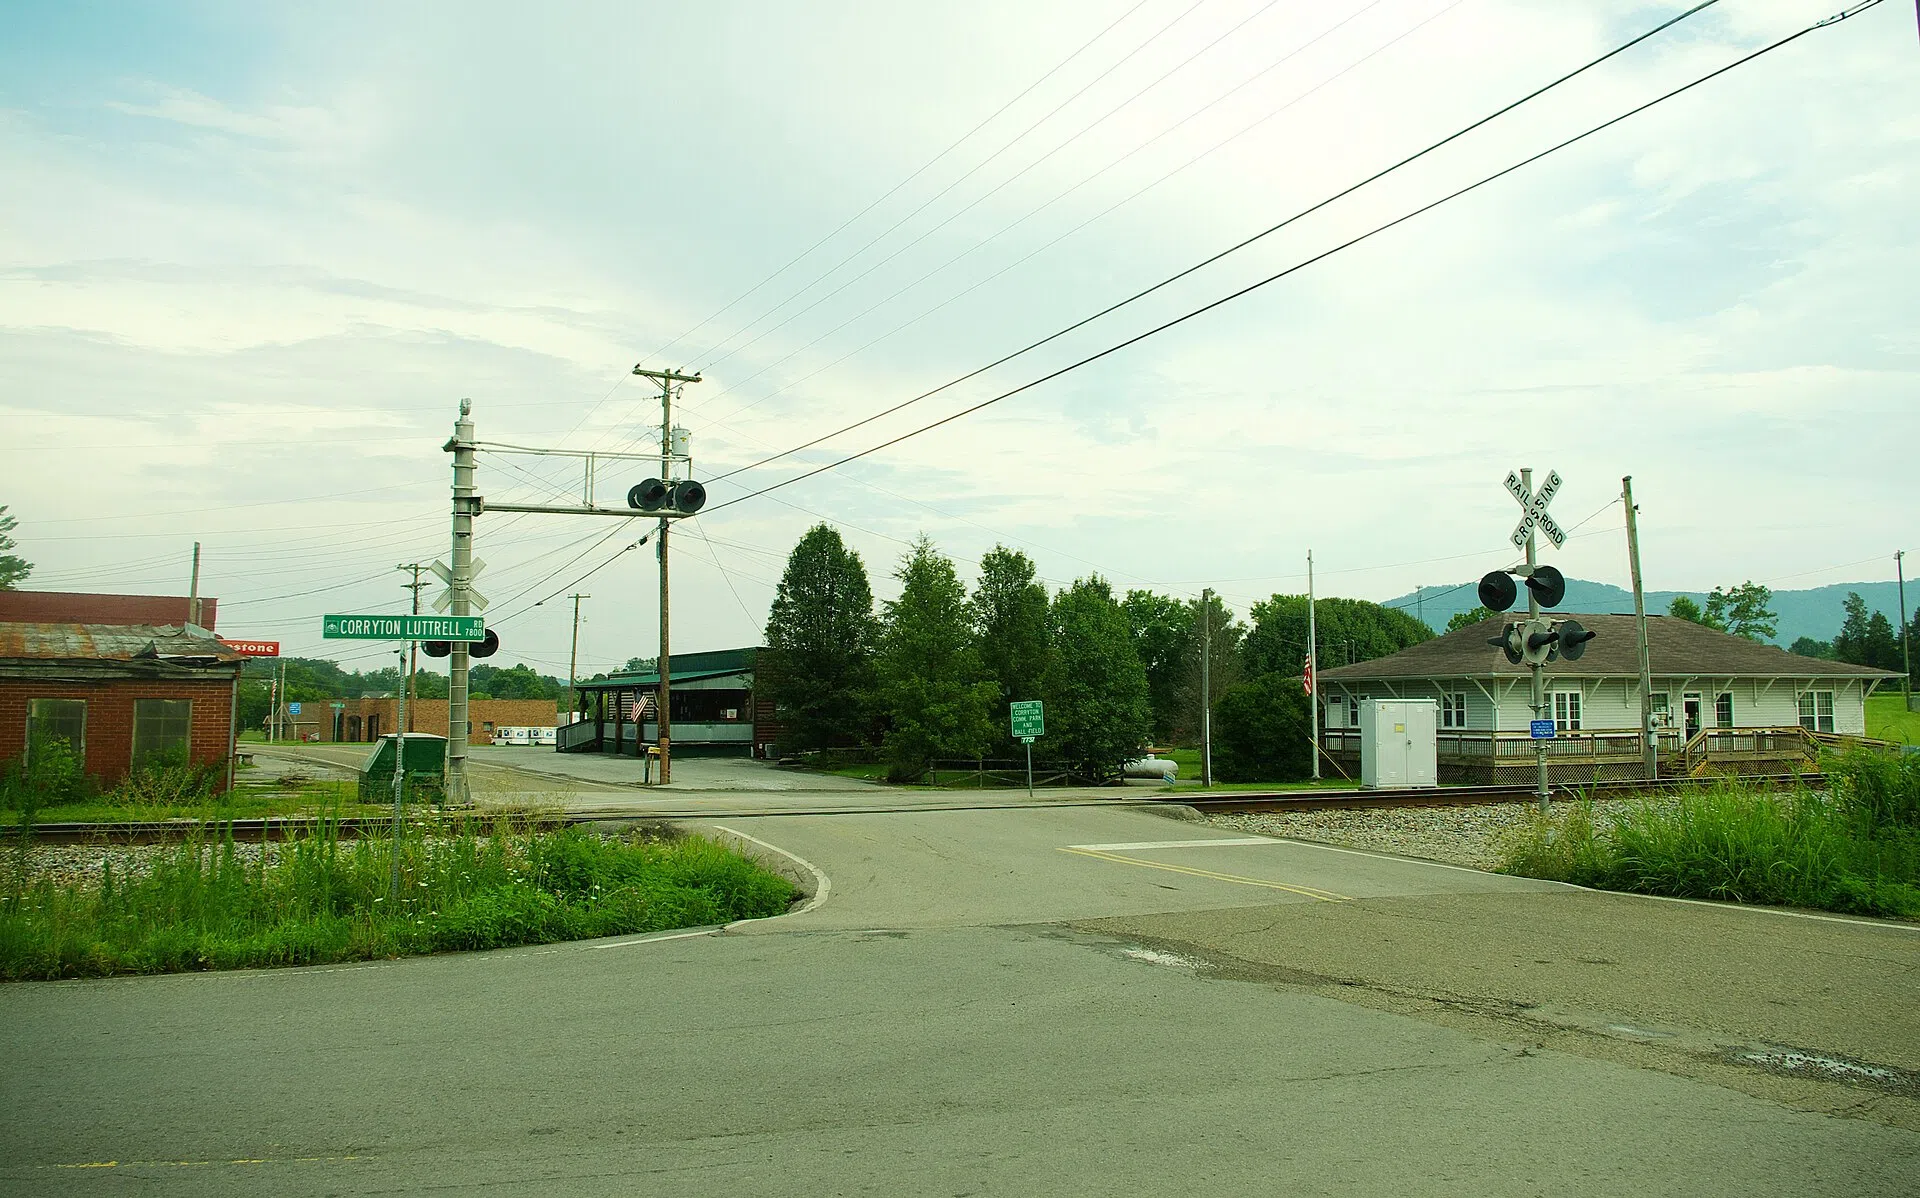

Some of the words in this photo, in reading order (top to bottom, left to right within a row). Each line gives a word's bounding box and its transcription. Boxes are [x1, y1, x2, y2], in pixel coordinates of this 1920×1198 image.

[1507, 474, 1530, 506] RAIL
[1540, 513, 1563, 544] ROAD
[1514, 474, 1560, 546] CROSSING
[340, 619, 401, 635] CORRYTON
[406, 620, 462, 636] LUTTRELL
[473, 620, 483, 629] RD
[465, 628, 483, 637] 7800
[227, 644, 274, 653] stone
